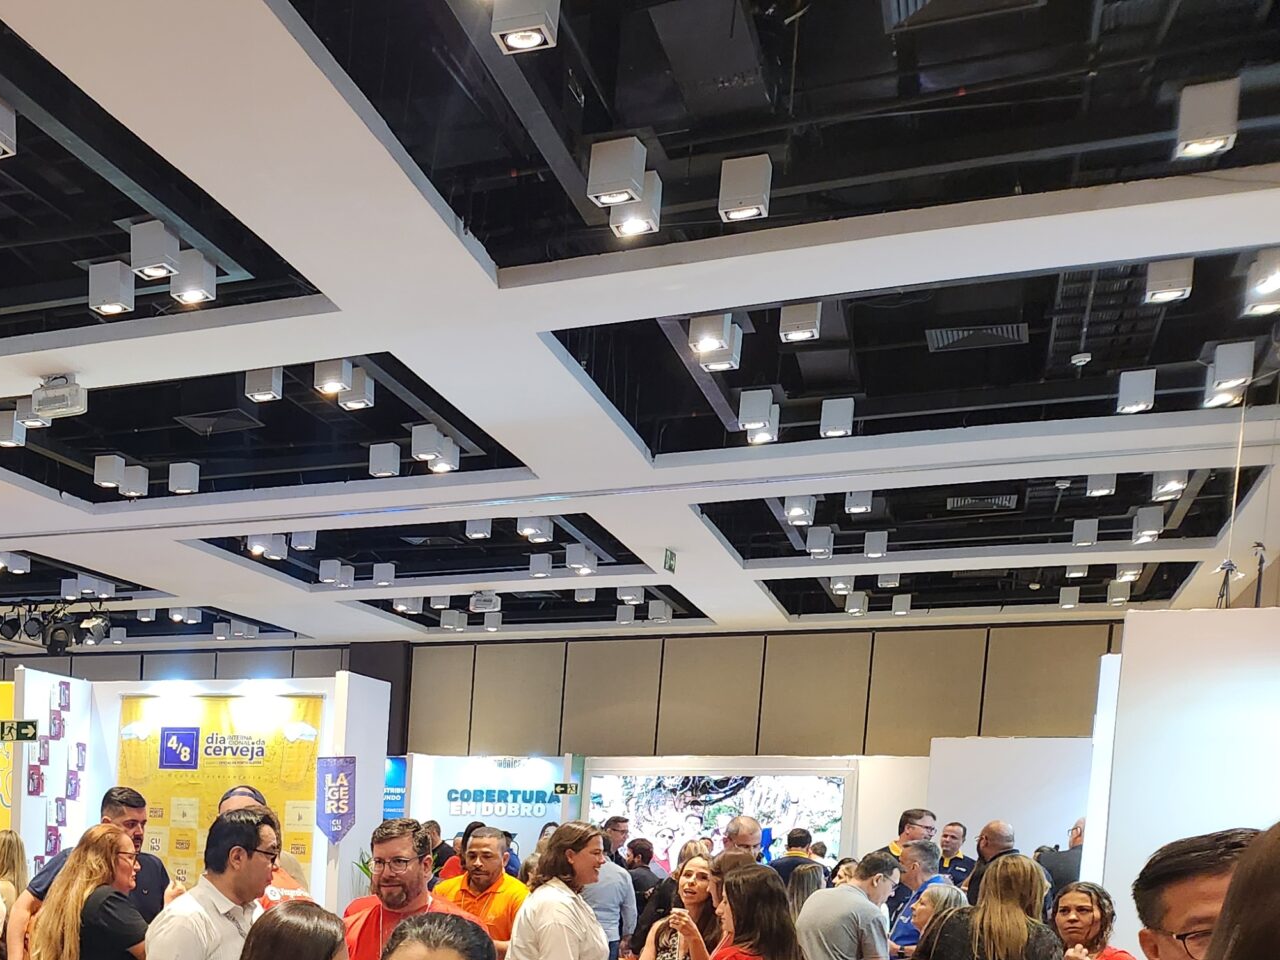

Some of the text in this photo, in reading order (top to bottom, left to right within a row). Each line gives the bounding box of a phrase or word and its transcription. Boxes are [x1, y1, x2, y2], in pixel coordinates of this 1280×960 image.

[205, 733, 226, 745] dia
[167, 735, 191, 761] 4/8
[204, 744, 265, 761] cerveja
[446, 788, 562, 804] COBERTURA
[449, 802, 548, 817] EM DOBRO
